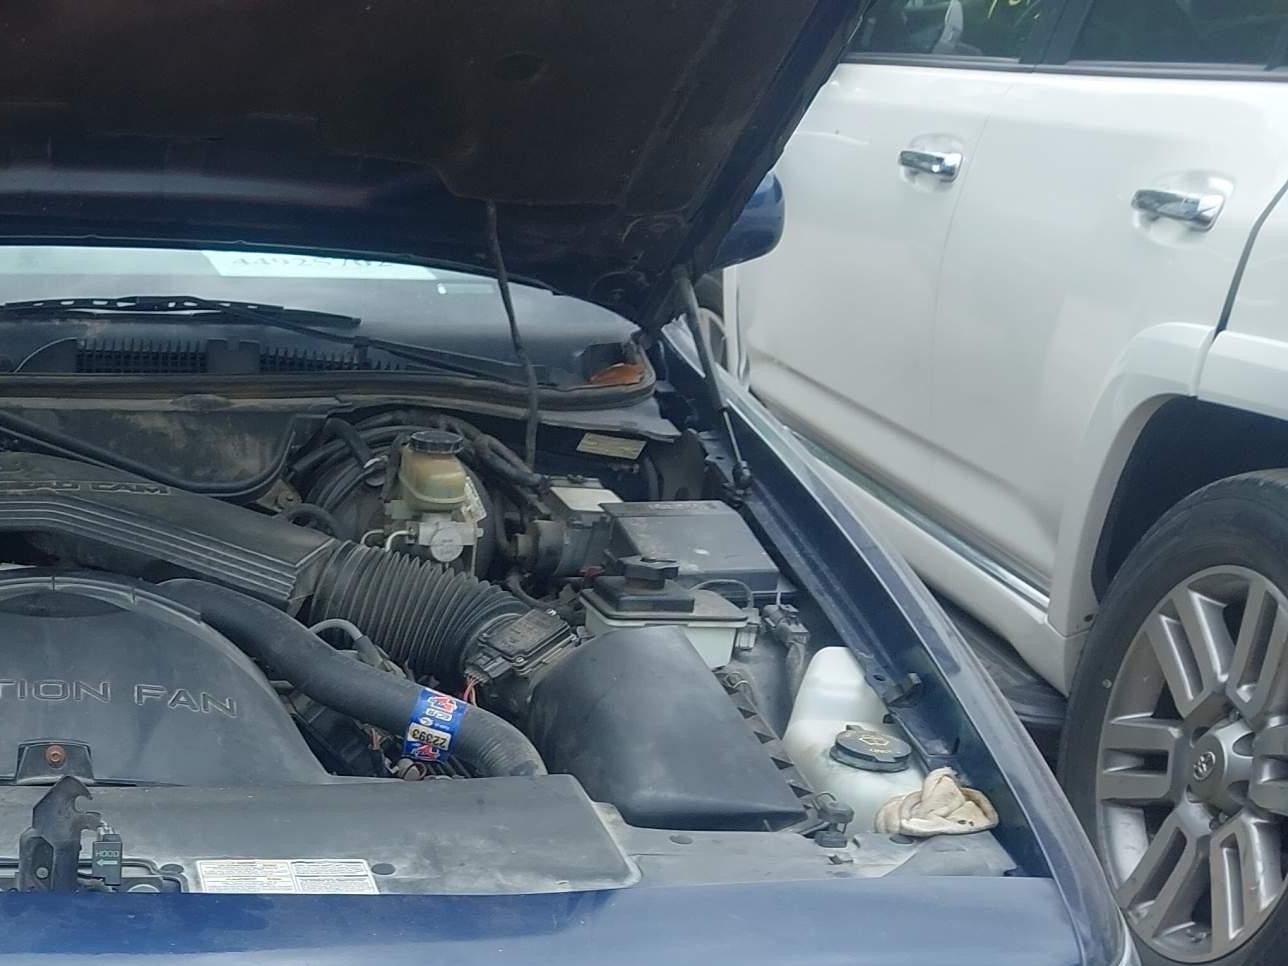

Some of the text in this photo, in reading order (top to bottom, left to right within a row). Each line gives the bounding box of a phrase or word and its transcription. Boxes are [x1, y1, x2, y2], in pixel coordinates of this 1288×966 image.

[133, 684, 238, 718] FAN
[411, 728, 449, 749] 22393
[96, 850, 120, 858] HOOD
